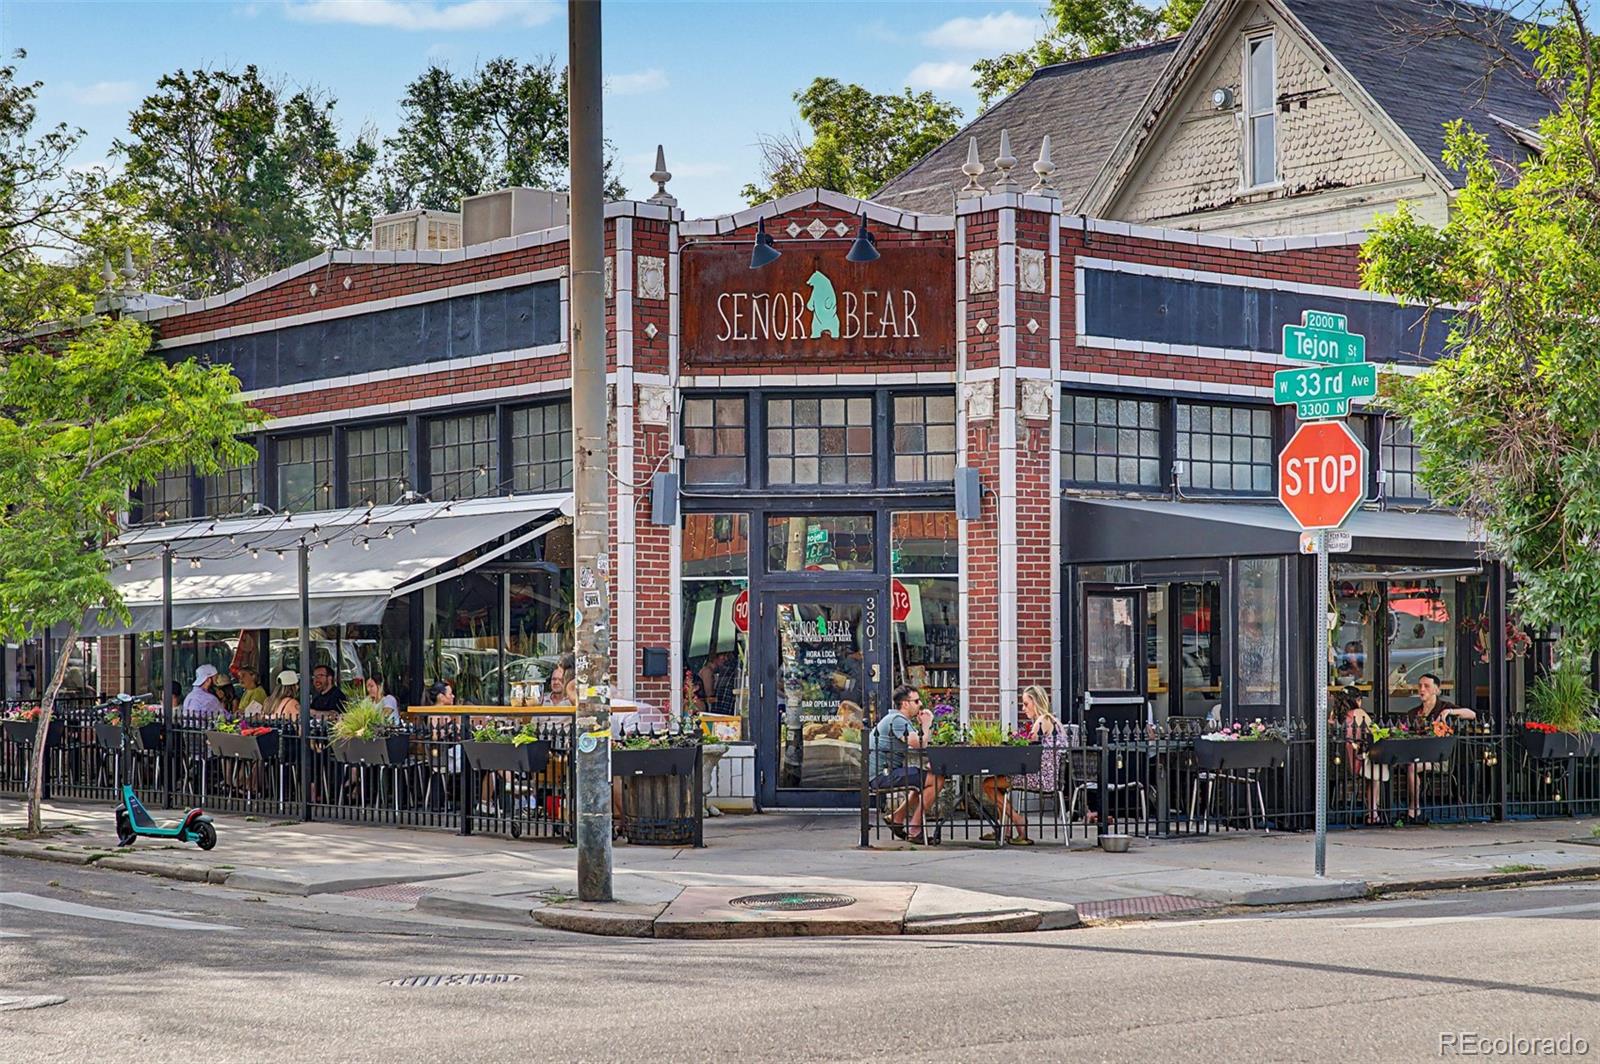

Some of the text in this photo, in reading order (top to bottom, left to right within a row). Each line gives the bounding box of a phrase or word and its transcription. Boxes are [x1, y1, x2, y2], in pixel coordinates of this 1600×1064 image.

[716, 290, 920, 341] SEÑOR BEAR
[1309, 314, 1345, 330] 2000 W
[1293, 331, 1357, 359] Tejon St
[1280, 371, 1369, 397] W 33rd Ave
[1300, 401, 1345, 417] 3300 N
[1285, 454, 1357, 496] STOP
[827, 620, 851, 636] BEAR
[866, 597, 876, 652] 3301
[805, 650, 820, 658] HORA
[827, 658, 838, 666] Daily
[801, 700, 841, 708] BAR OPEN LATE
[799, 714, 821, 722] SUNDAY
